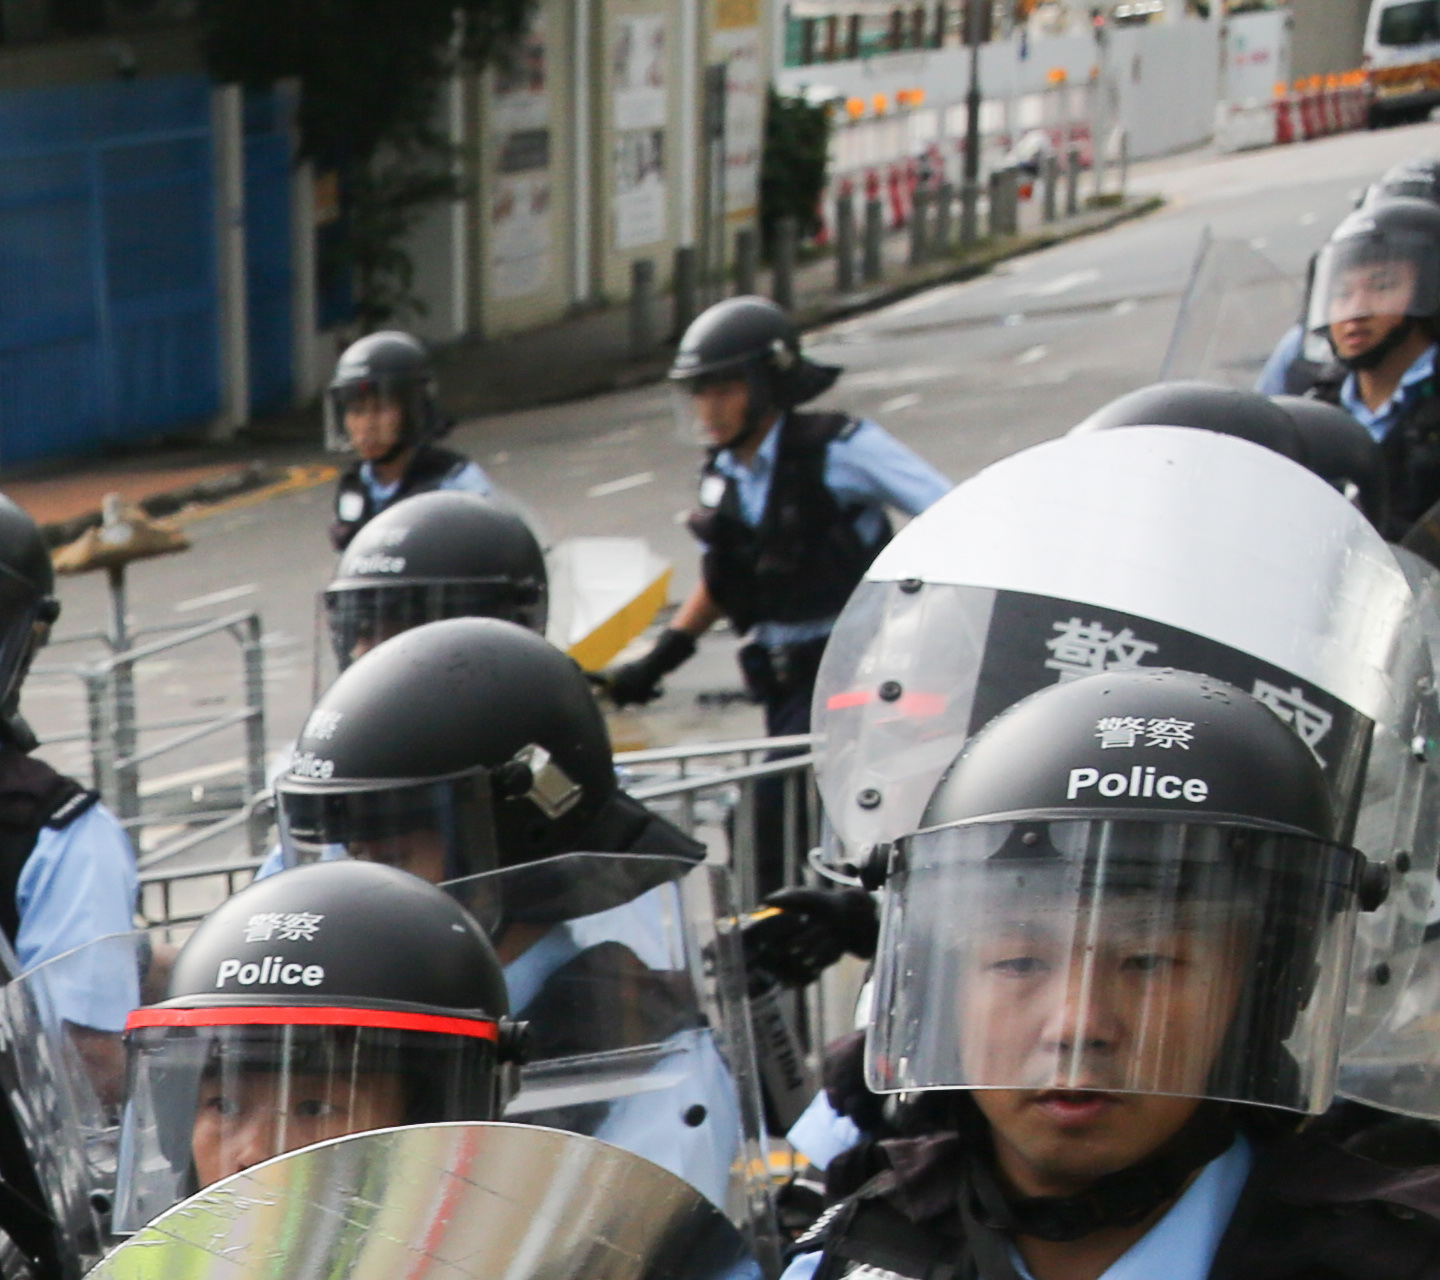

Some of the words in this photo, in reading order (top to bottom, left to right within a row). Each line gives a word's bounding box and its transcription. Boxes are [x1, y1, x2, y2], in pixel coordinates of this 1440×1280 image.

[1094, 715, 1195, 750] 警察
[1067, 765, 1209, 803] Police
[244, 911, 325, 944] 警察
[216, 956, 325, 988] Police
